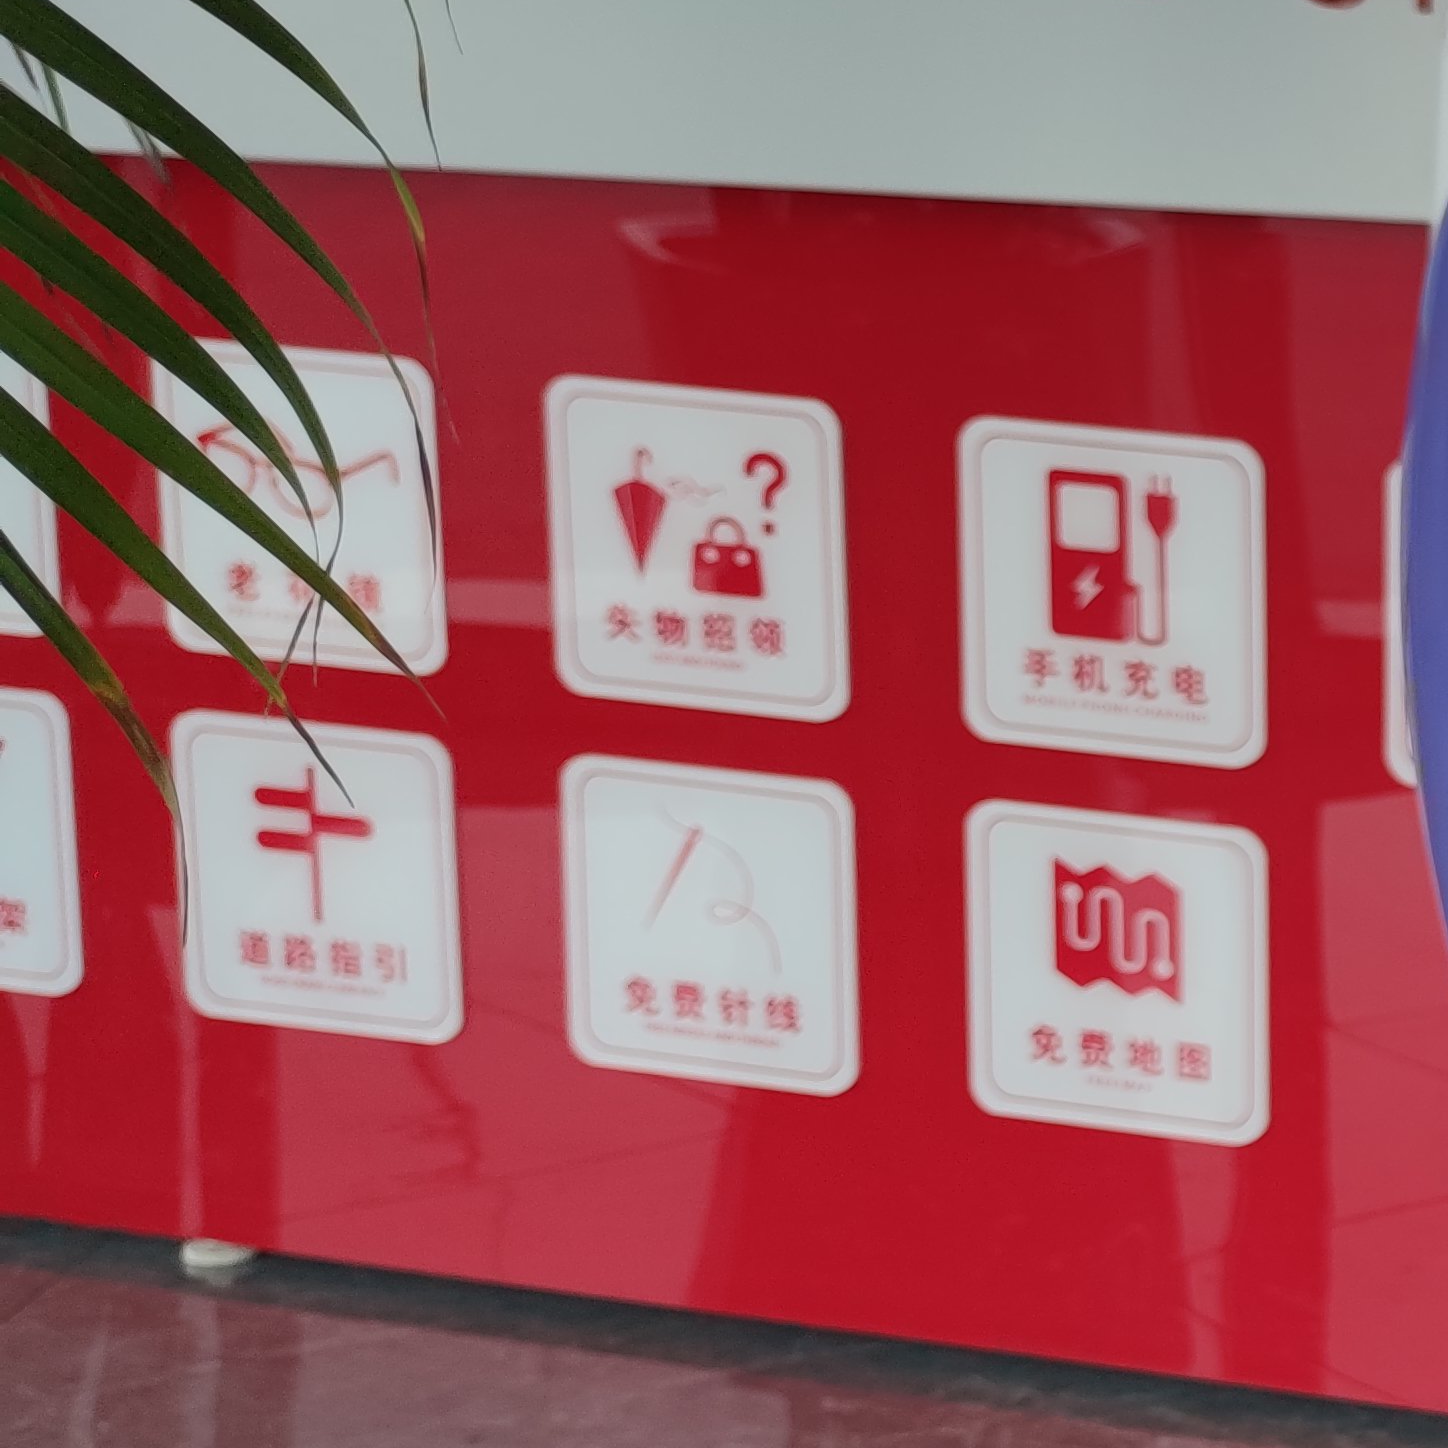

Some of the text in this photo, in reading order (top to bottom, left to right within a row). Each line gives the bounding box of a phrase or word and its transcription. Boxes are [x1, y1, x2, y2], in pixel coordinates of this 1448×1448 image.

[1023, 648, 1208, 704] 手机充电
[239, 930, 409, 984] 道路指引
[624, 975, 802, 1032] 免费针线
[1029, 1023, 1214, 1081] 免费地图
